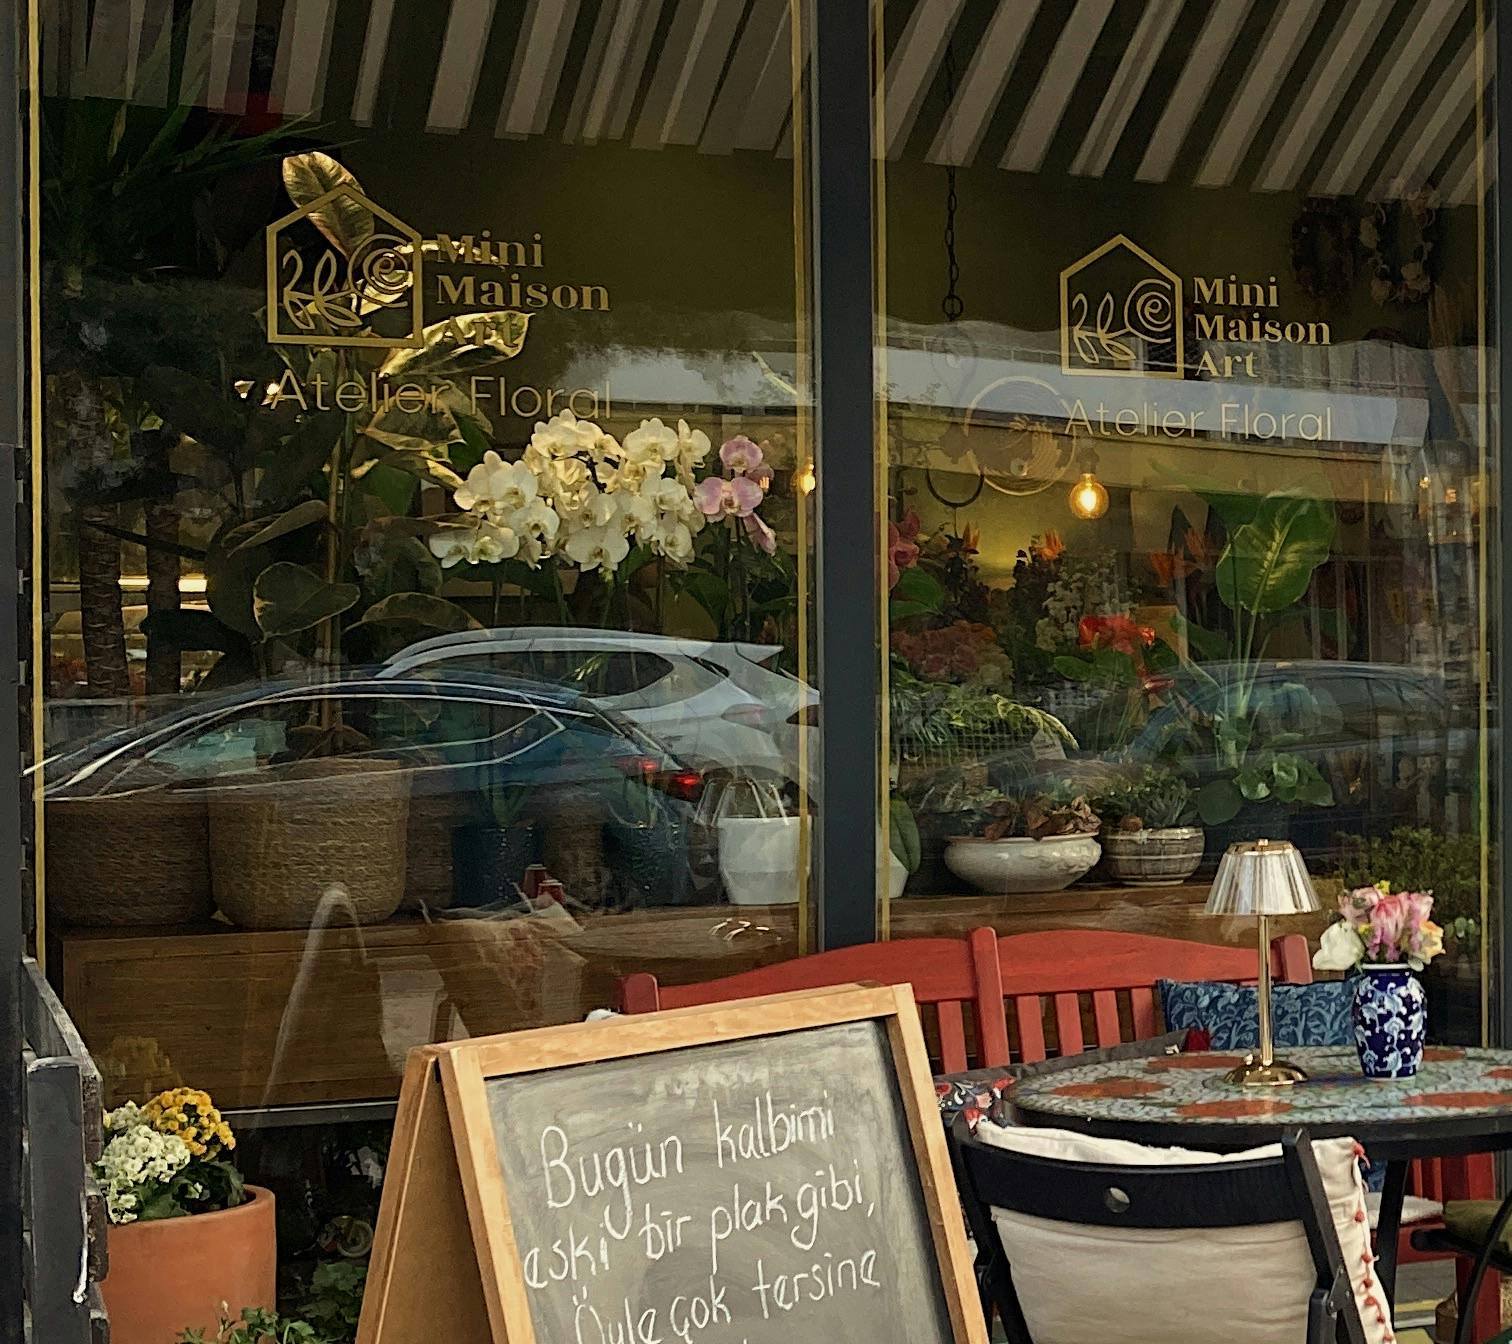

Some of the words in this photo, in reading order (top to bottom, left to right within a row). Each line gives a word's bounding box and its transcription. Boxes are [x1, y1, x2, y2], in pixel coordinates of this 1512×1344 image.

[436, 229, 544, 267] Mini
[436, 273, 610, 311] Maison
[1193, 274, 1279, 308] Mini
[443, 316, 520, 348] Art
[1194, 312, 1331, 345] Maison
[1195, 350, 1259, 378] Art
[270, 369, 452, 414] Atelier
[471, 376, 612, 419] Floral
[1065, 399, 1204, 438] Atelier
[1220, 403, 1331, 441] Floral
[541, 1122, 682, 1240] Bugün
[714, 1090, 834, 1168] kalbimi
[524, 1223, 609, 1288] eski
[639, 1203, 691, 1260] bir
[711, 1182, 787, 1274] plak
[670, 1274, 731, 1344] çok
[752, 1250, 880, 1319] tersine
